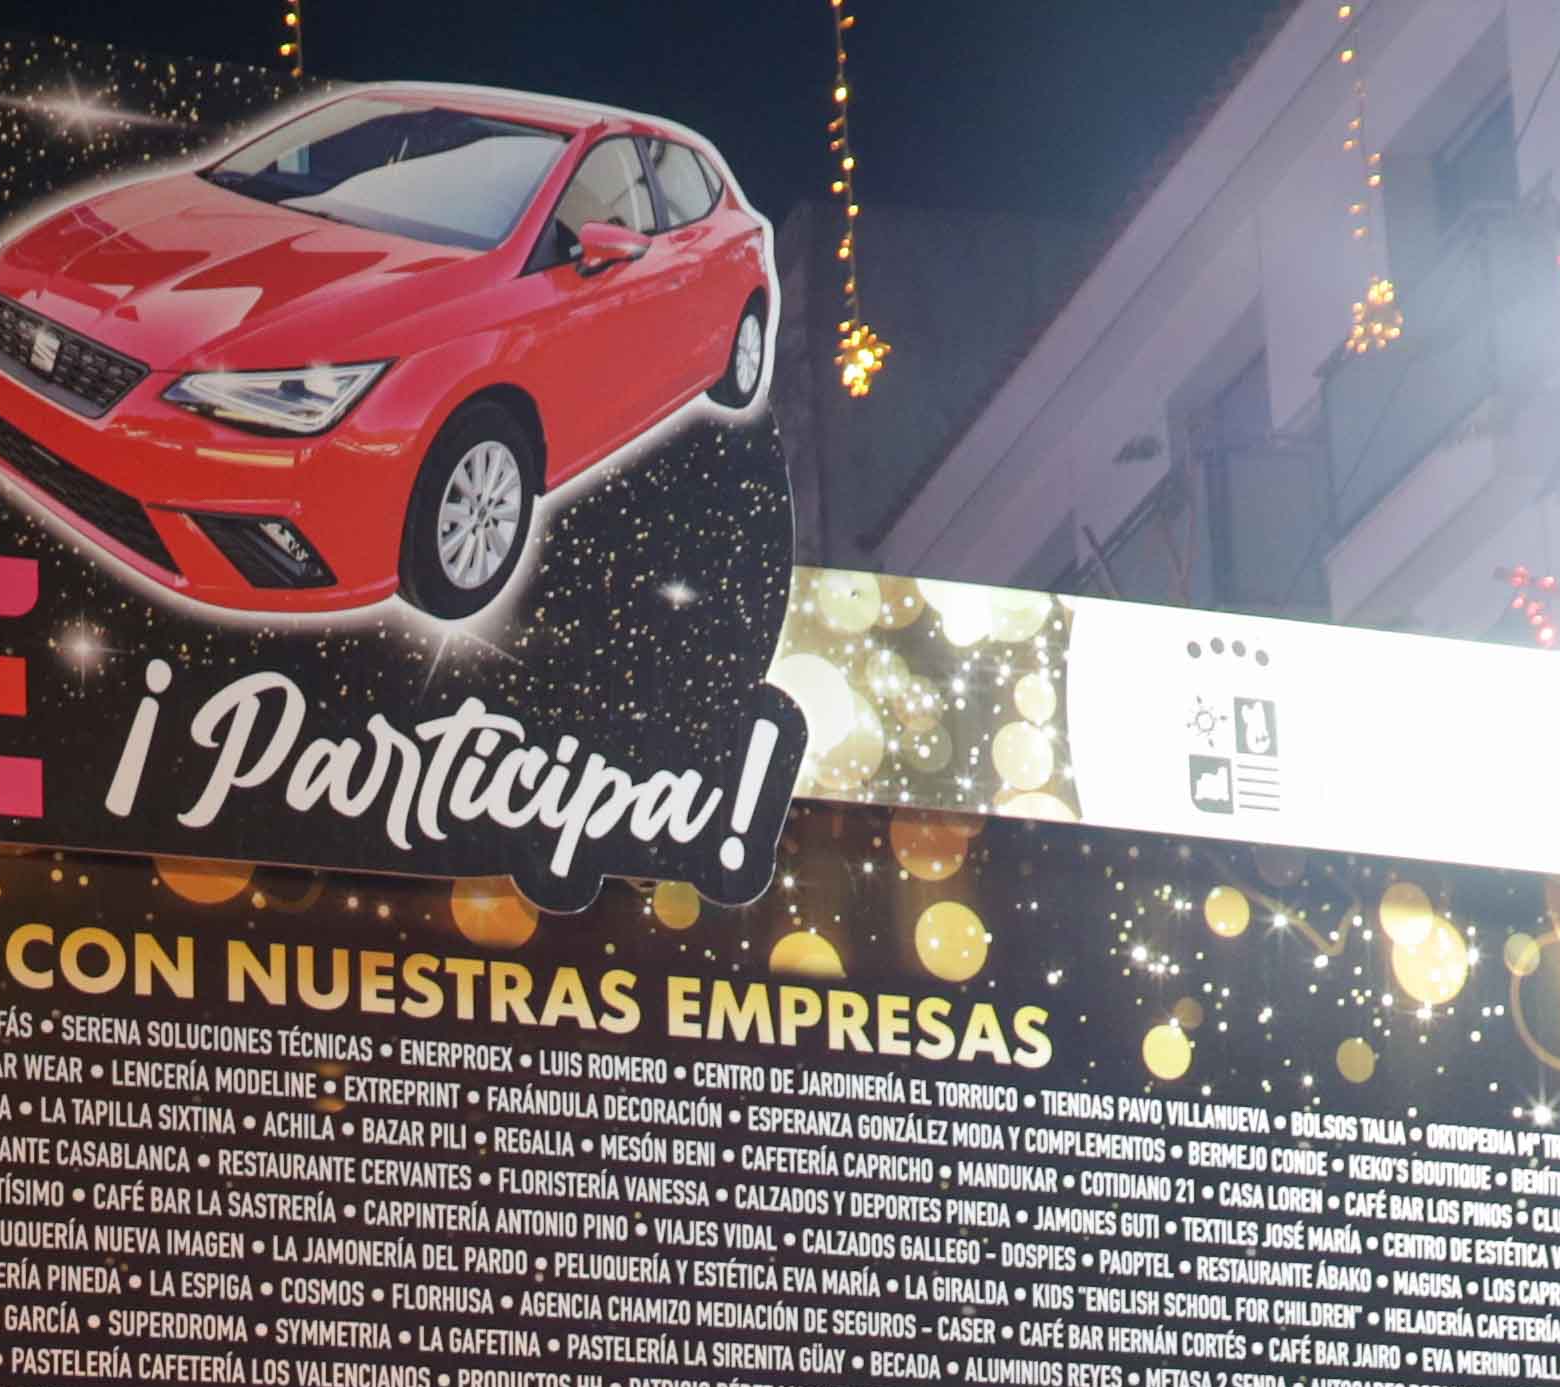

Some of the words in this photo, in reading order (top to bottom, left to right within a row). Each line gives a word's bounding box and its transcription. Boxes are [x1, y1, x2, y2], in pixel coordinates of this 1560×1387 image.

[6, 924, 194, 998] CON
[228, 941, 640, 1034] NUESTRAS
[668, 975, 1052, 1068] EMPRESAS
[401, 1039, 513, 1072] ENERPROEX
[57, 1140, 190, 1173] CASABLANCA
